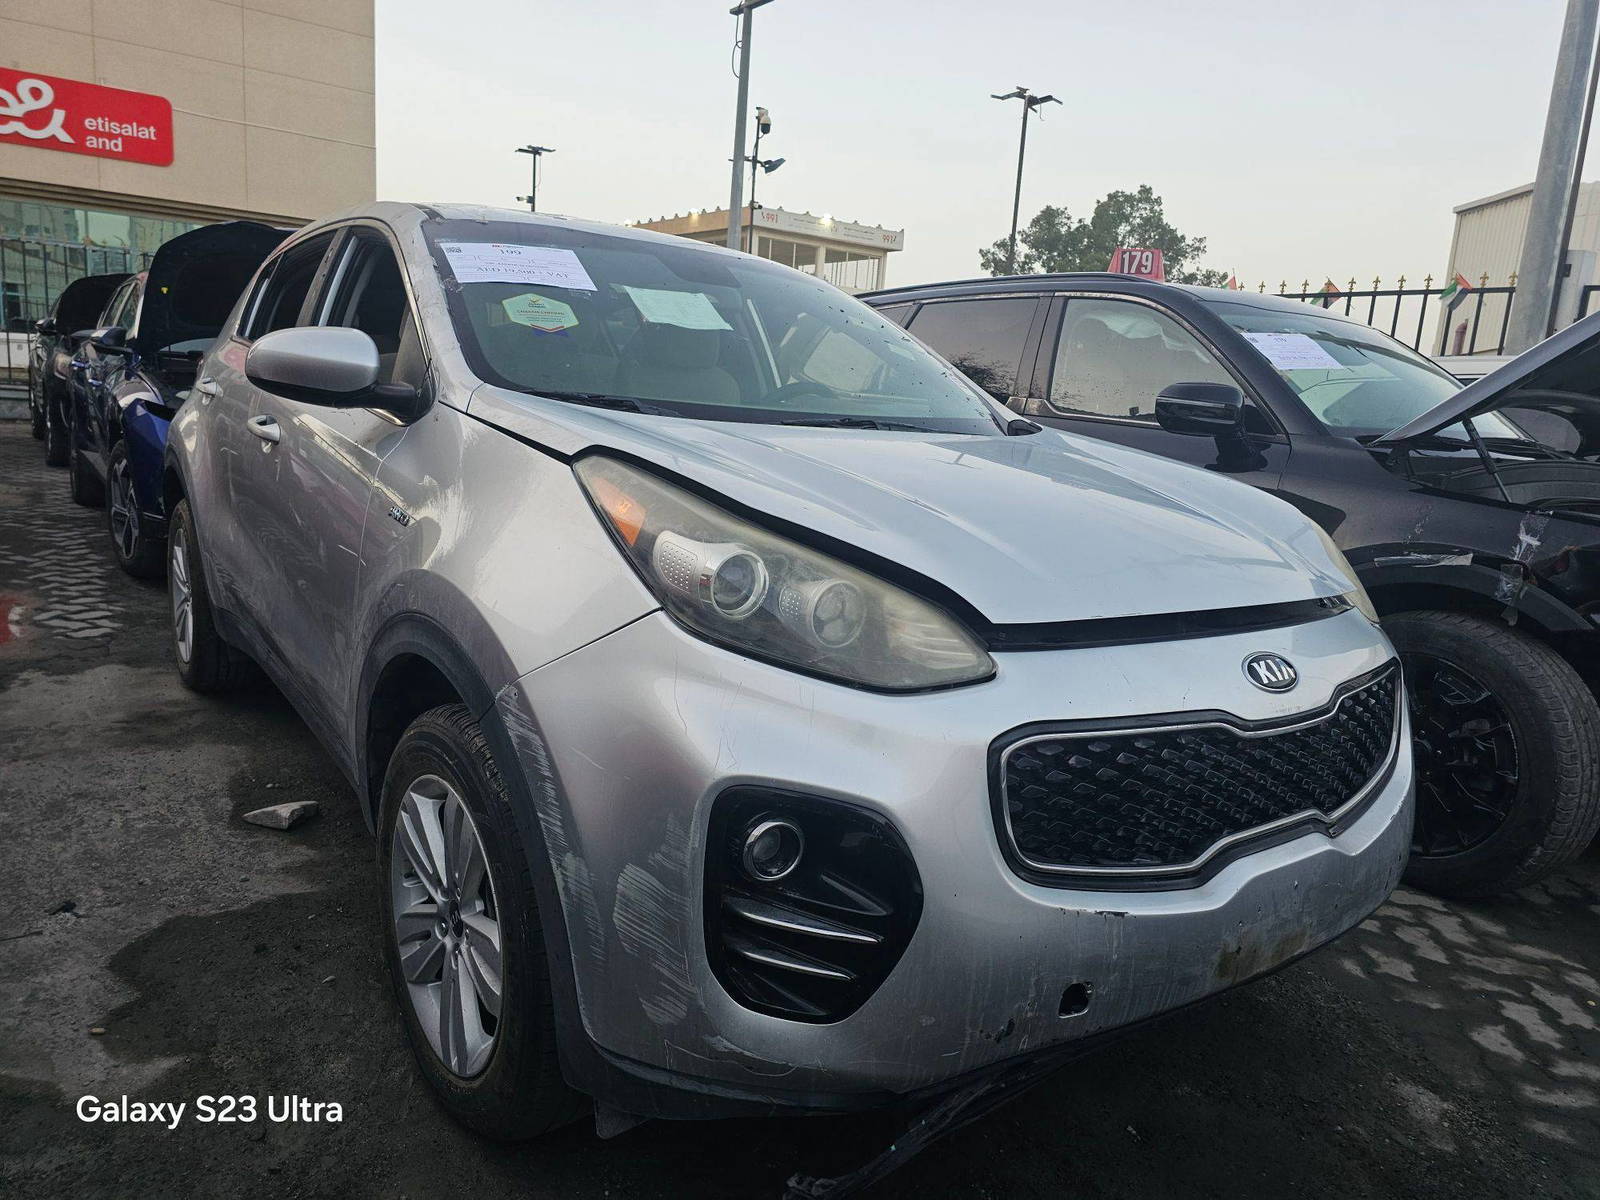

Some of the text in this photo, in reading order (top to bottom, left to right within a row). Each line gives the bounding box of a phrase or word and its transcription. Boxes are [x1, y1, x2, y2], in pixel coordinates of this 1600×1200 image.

[84, 117, 157, 141] etisalat
[86, 136, 123, 152] and
[1122, 250, 1153, 274] 179
[1250, 658, 1296, 684] KIA
